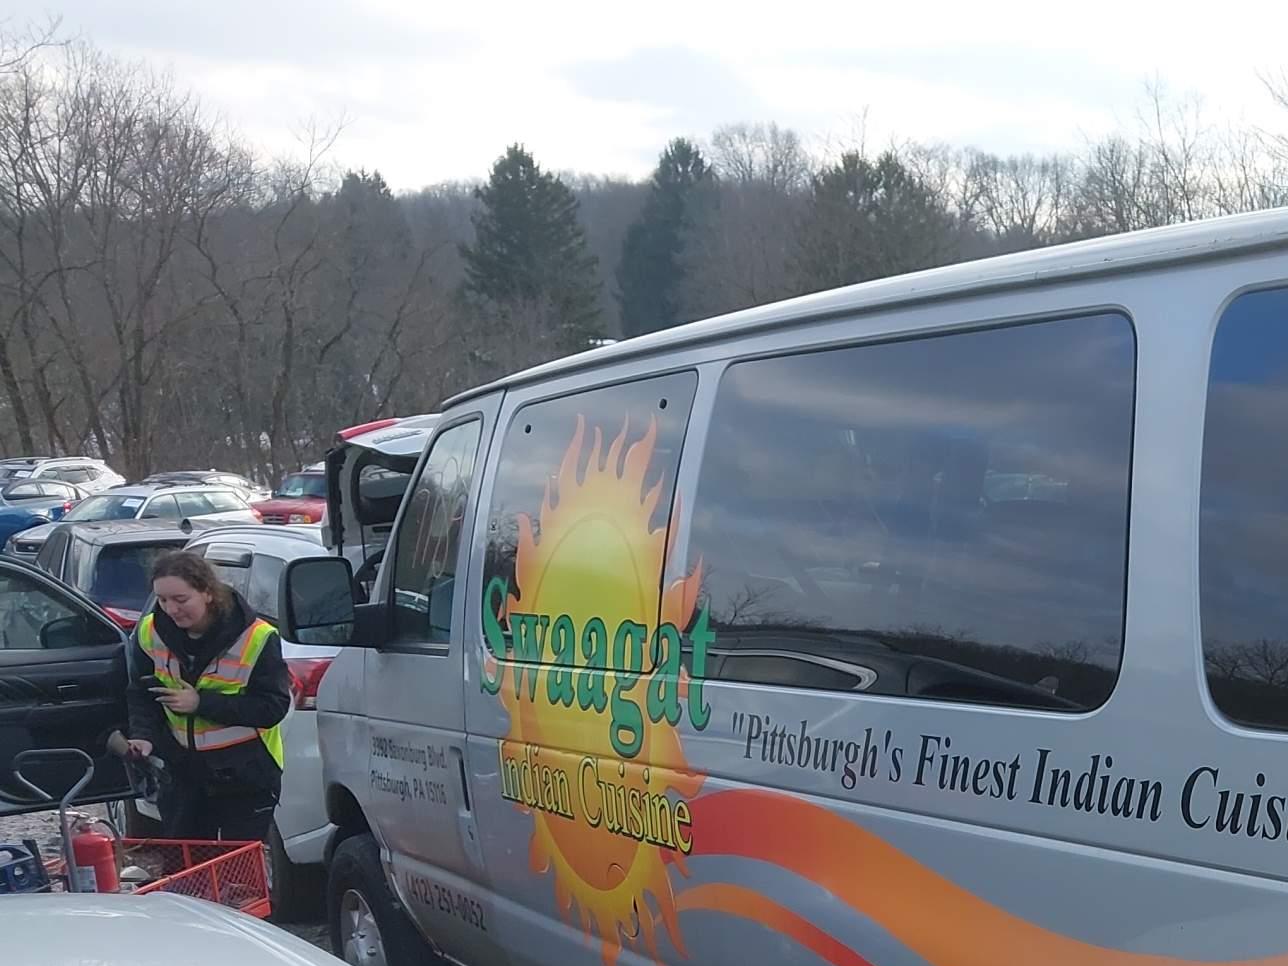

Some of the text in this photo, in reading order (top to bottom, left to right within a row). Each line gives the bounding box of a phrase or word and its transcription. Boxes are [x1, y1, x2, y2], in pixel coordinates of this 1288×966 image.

[480, 576, 716, 758] Swaagat
[499, 738, 694, 856] Indian Cuisine
[731, 711, 904, 790] "Pittsburgh's
[913, 734, 1021, 802] Finest
[1027, 747, 1163, 822] Indian
